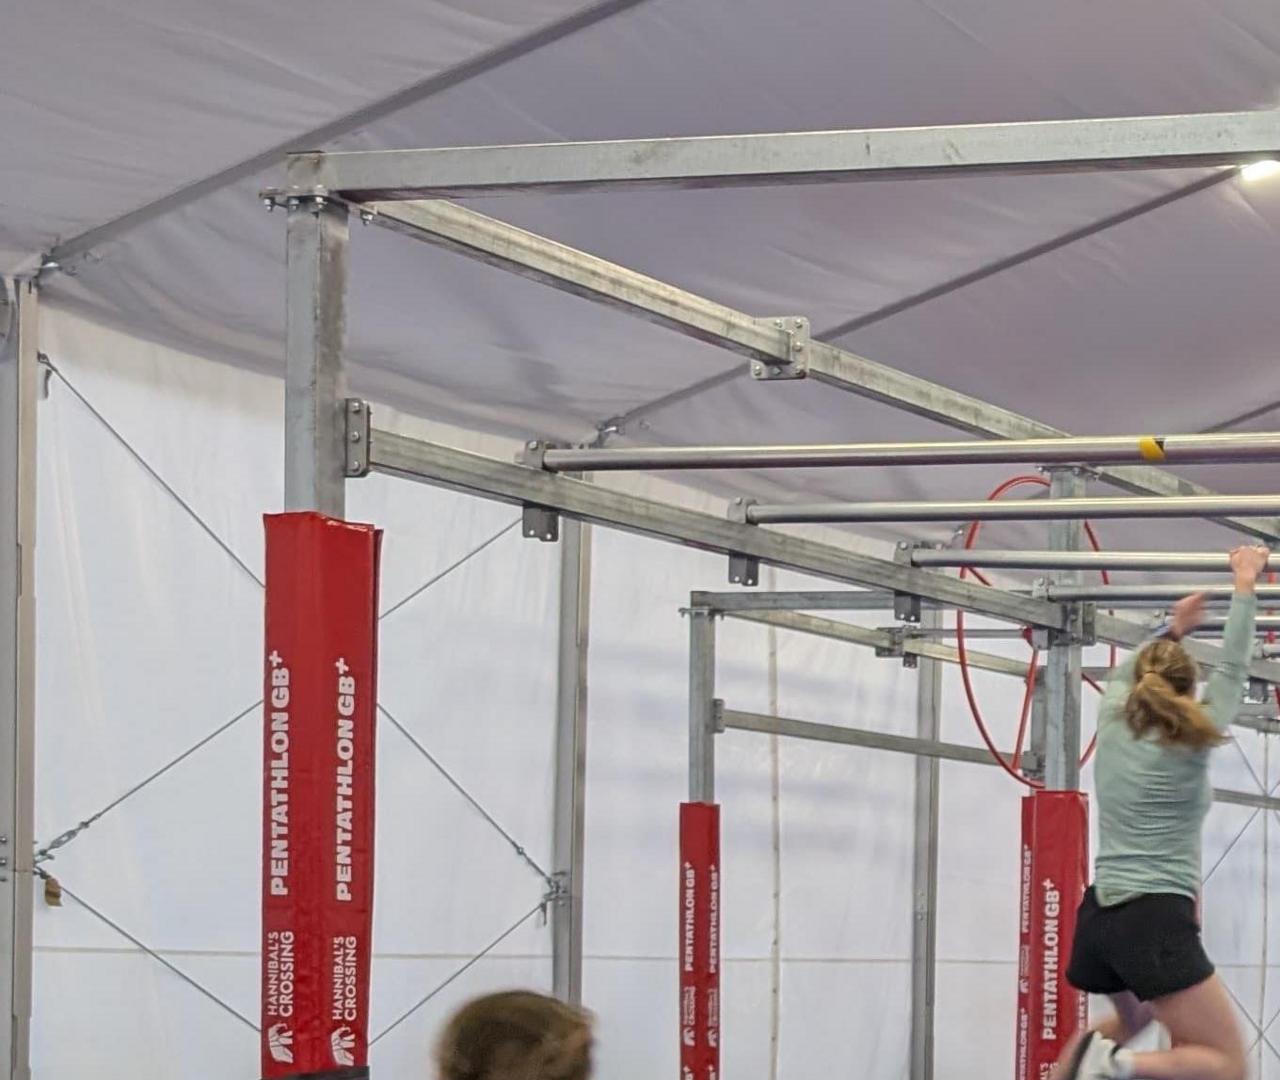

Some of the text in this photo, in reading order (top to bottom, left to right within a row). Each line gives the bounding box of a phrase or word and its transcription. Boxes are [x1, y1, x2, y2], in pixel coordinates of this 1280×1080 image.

[271, 713, 288, 895] PENTATHLON
[336, 720, 353, 900] PENTATHLON
[268, 931, 279, 1016] HANNIBAL'S
[279, 930, 294, 1017] CROSSING
[332, 935, 344, 1020] HANNIBAL'S
[343, 935, 357, 1021] CROSSING
[1042, 919, 1059, 1040] PENTATHLON
